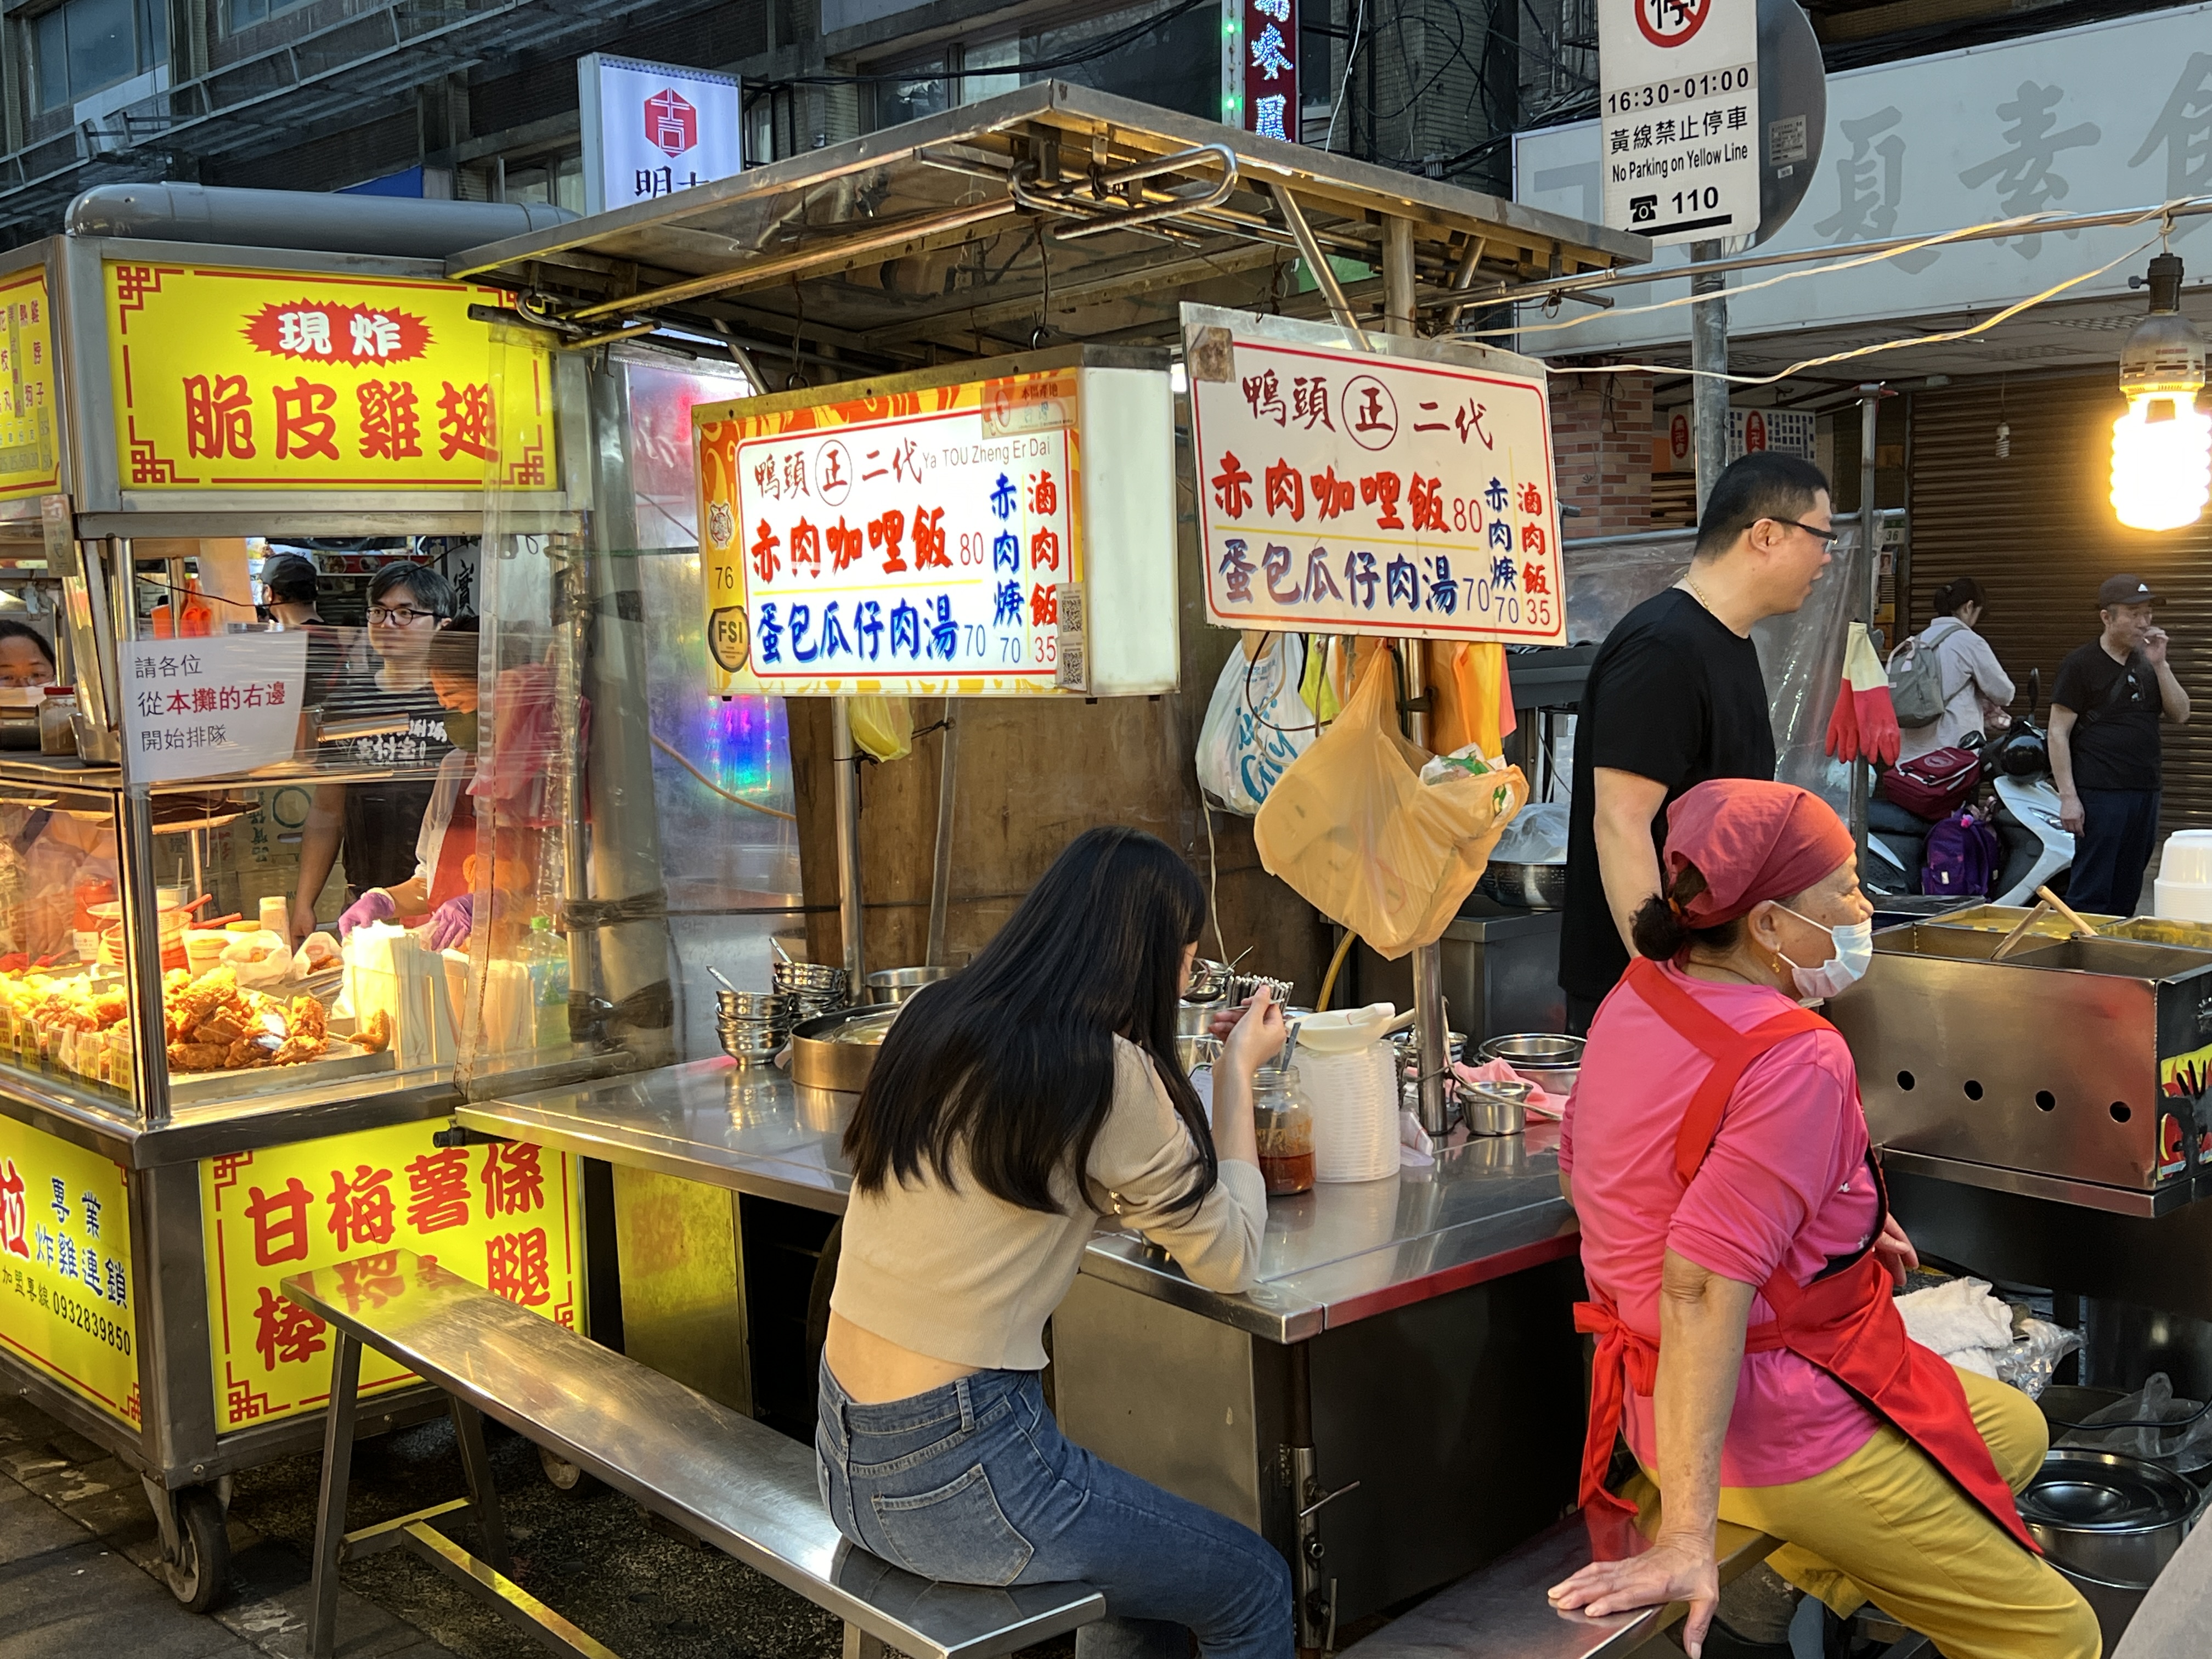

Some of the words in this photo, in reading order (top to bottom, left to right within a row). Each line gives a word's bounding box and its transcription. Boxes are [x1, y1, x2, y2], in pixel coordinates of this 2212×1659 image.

[1608, 67, 1748, 114] 16:30-01:00
[1610, 106, 1748, 155] 黃線禁止停車
[1612, 165, 1626, 183] No
[1629, 157, 1668, 178] Parking
[1671, 156, 1684, 171] on
[1686, 148, 1722, 169] Yellow
[1724, 142, 1748, 162] Line
[1672, 186, 1719, 214] 110
[277, 311, 402, 357] 現炸
[182, 373, 499, 462] 脆皮雞翅
[923, 452, 936, 469] Ya
[943, 447, 968, 466] TOU
[972, 444, 1009, 465] Zheng
[1013, 440, 1026, 459] Er
[1030, 436, 1050, 456] Dai
[1454, 498, 1482, 533] 80
[960, 532, 984, 566] 80
[1027, 469, 1059, 628] 滷肉飯
[1517, 482, 1551, 595] 滷肉飯
[715, 566, 734, 590] 76
[1219, 539, 1459, 616] 蛋包瓜仔肉湯
[1463, 578, 1490, 612] 70
[757, 593, 959, 664] 蛋包瓜仔肉湯
[964, 624, 986, 658] 70
[1495, 596, 1519, 624] 70
[1526, 599, 1550, 625] 35
[718, 620, 743, 644] FSI
[1000, 636, 1021, 664] 70
[1035, 635, 1056, 662] 35
[134, 654, 202, 679] 請各位
[138, 681, 285, 717] 從本攤的右邊
[142, 724, 228, 752] 開始排隊
[51, 1177, 101, 1239] 專業
[244, 1142, 544, 1267] 甘梅薯條
[35, 1223, 127, 1310] 炸雞連鎖
[2, 1266, 50, 1310] 加盟專線
[53, 1290, 131, 1356] 0932839850
